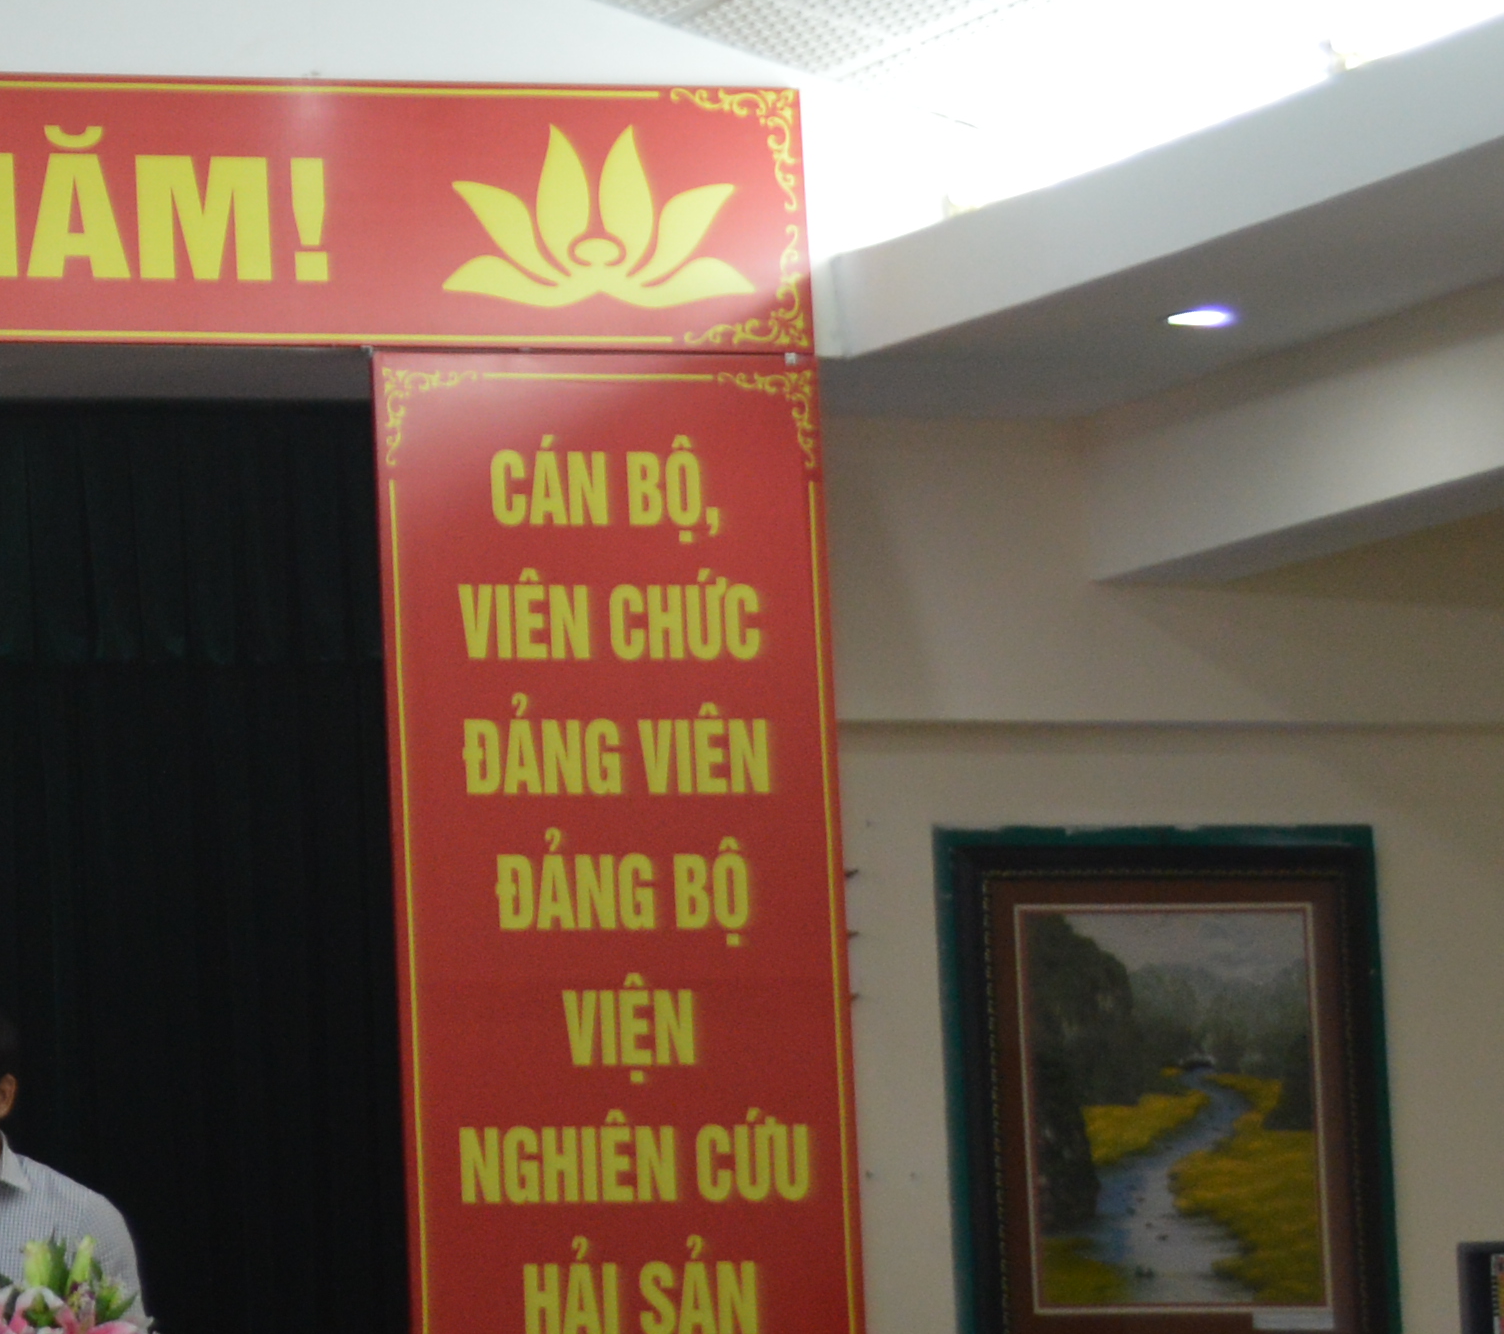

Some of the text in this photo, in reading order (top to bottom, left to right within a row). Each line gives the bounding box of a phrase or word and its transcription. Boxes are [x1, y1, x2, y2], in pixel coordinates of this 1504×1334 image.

[492, 436, 720, 543] CÁN BỘ,
[459, 569, 761, 660] VIÊN CHỨC
[464, 694, 771, 795] ĐẢNG VIÊN
[496, 828, 750, 946] ĐẢNG BỘ
[564, 974, 696, 1083] VIỆN
[460, 1108, 811, 1204] NGHIÊN CỨU
